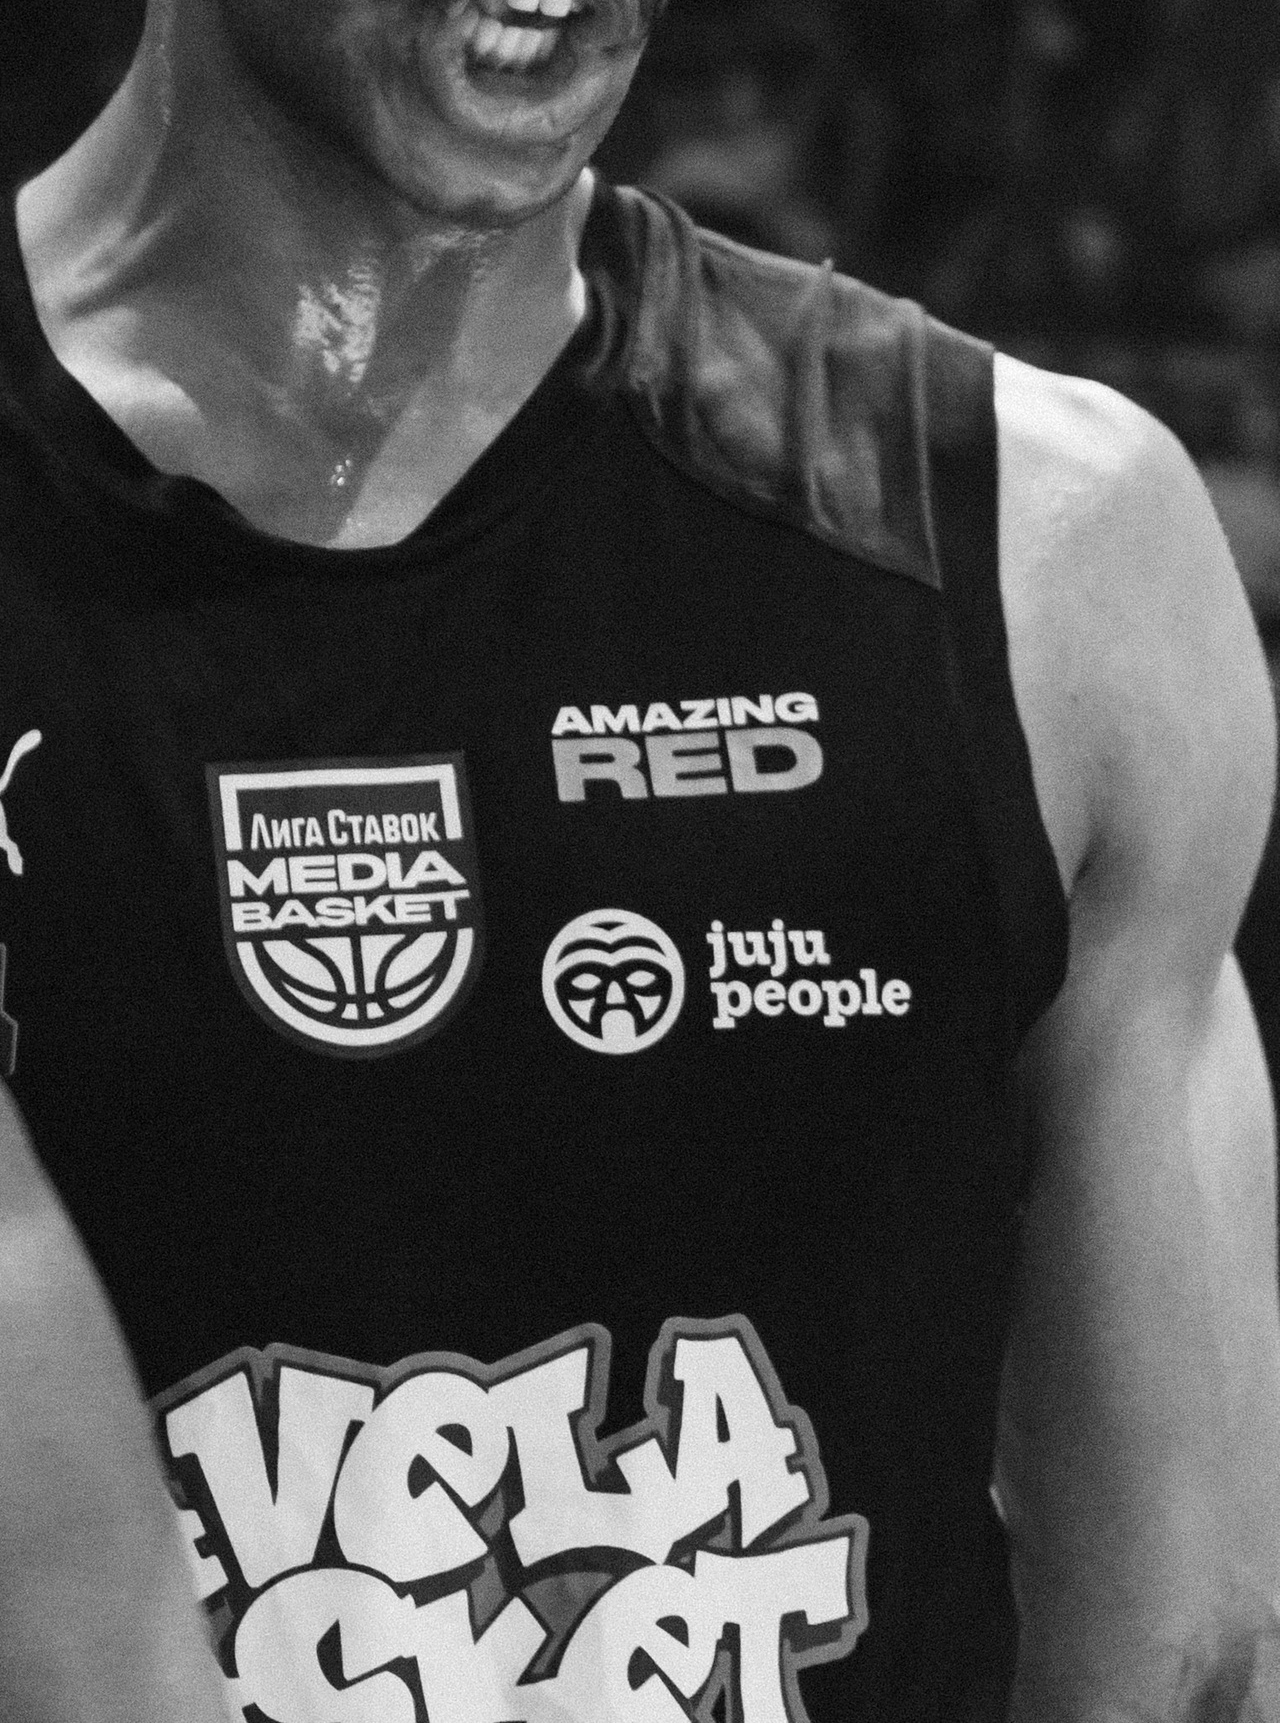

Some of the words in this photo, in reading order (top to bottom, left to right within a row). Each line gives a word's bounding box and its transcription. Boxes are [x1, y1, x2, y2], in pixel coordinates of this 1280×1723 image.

[551, 691, 820, 736] AMAZING
[551, 727, 823, 802] RED
[226, 849, 467, 898] MEDIA
[230, 889, 471, 933] BASKET
[705, 918, 831, 979] juju
[710, 968, 912, 1030] people
